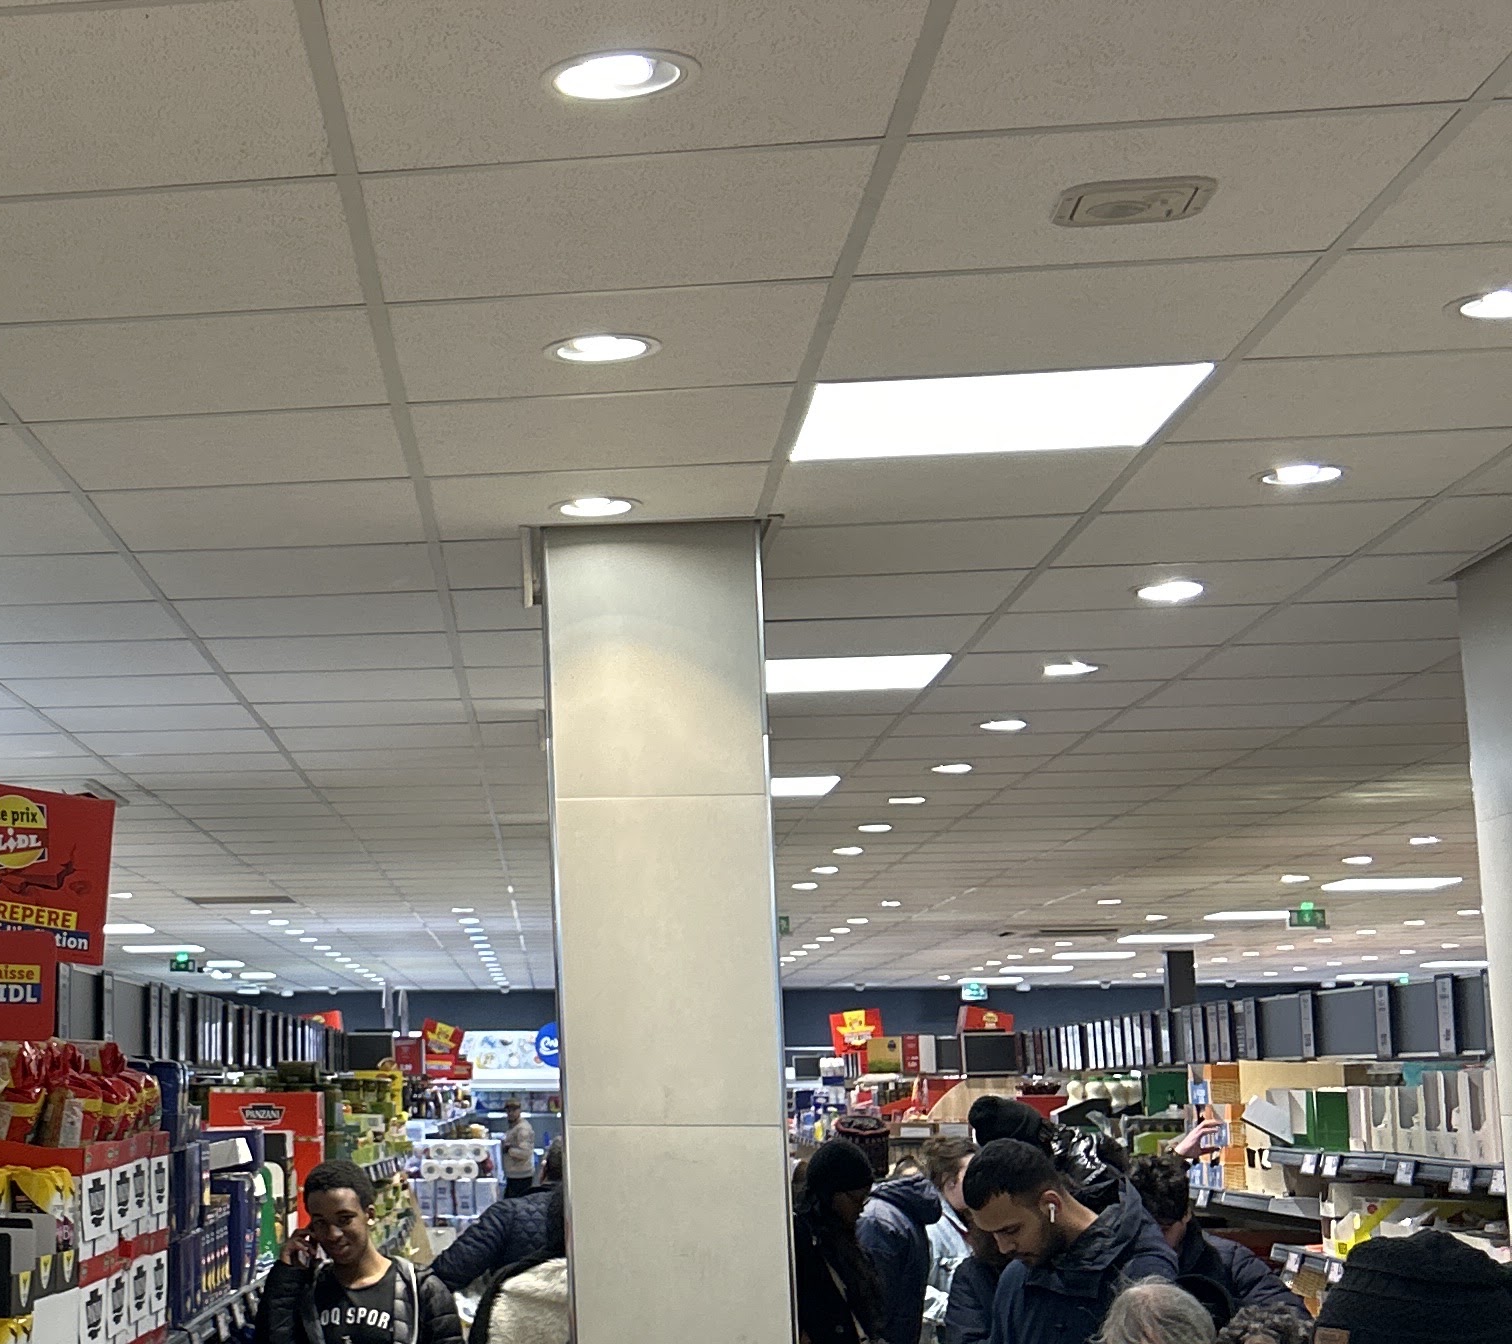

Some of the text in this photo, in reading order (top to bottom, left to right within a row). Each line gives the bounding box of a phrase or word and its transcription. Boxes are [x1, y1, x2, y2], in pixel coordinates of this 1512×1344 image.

[11, 807, 38, 826] prix
[244, 1109, 281, 1121] PANZANI
[320, 1307, 394, 1332] OQ SPOR
